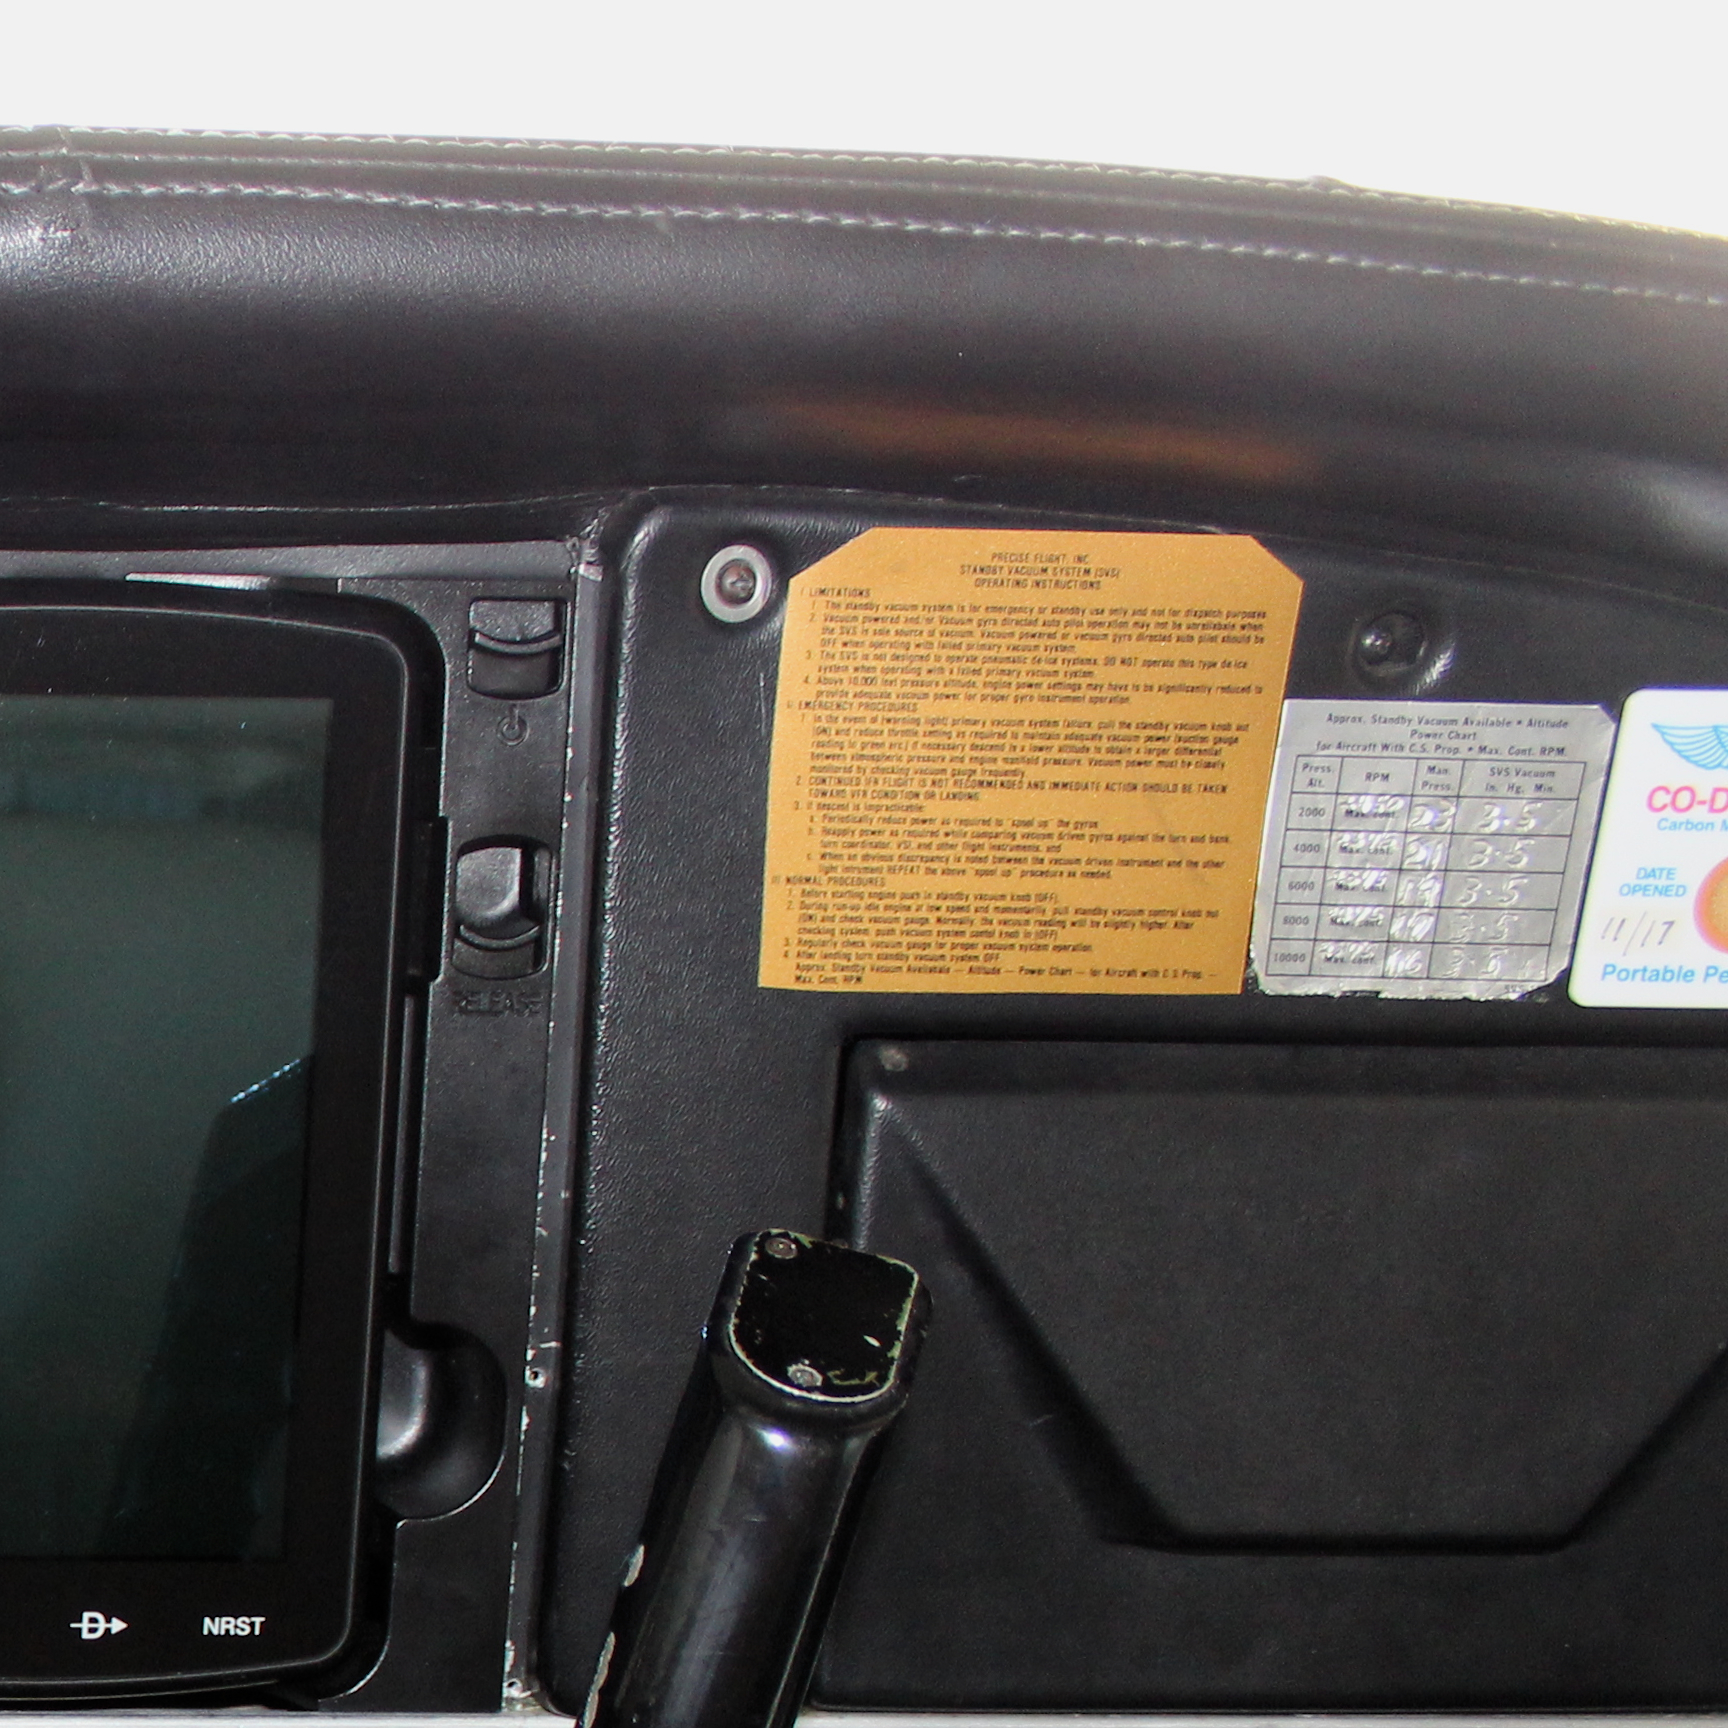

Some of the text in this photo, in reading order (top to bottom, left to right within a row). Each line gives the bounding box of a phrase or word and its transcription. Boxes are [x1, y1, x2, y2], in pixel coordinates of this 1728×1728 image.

[1371, 714, 1412, 727] Standby
[1297, 807, 1325, 818] 2000
[1636, 866, 1676, 881] DATE
[1619, 883, 1687, 898] OPENED
[1600, 963, 1694, 984] Portable
[202, 1616, 265, 1636] NRST
